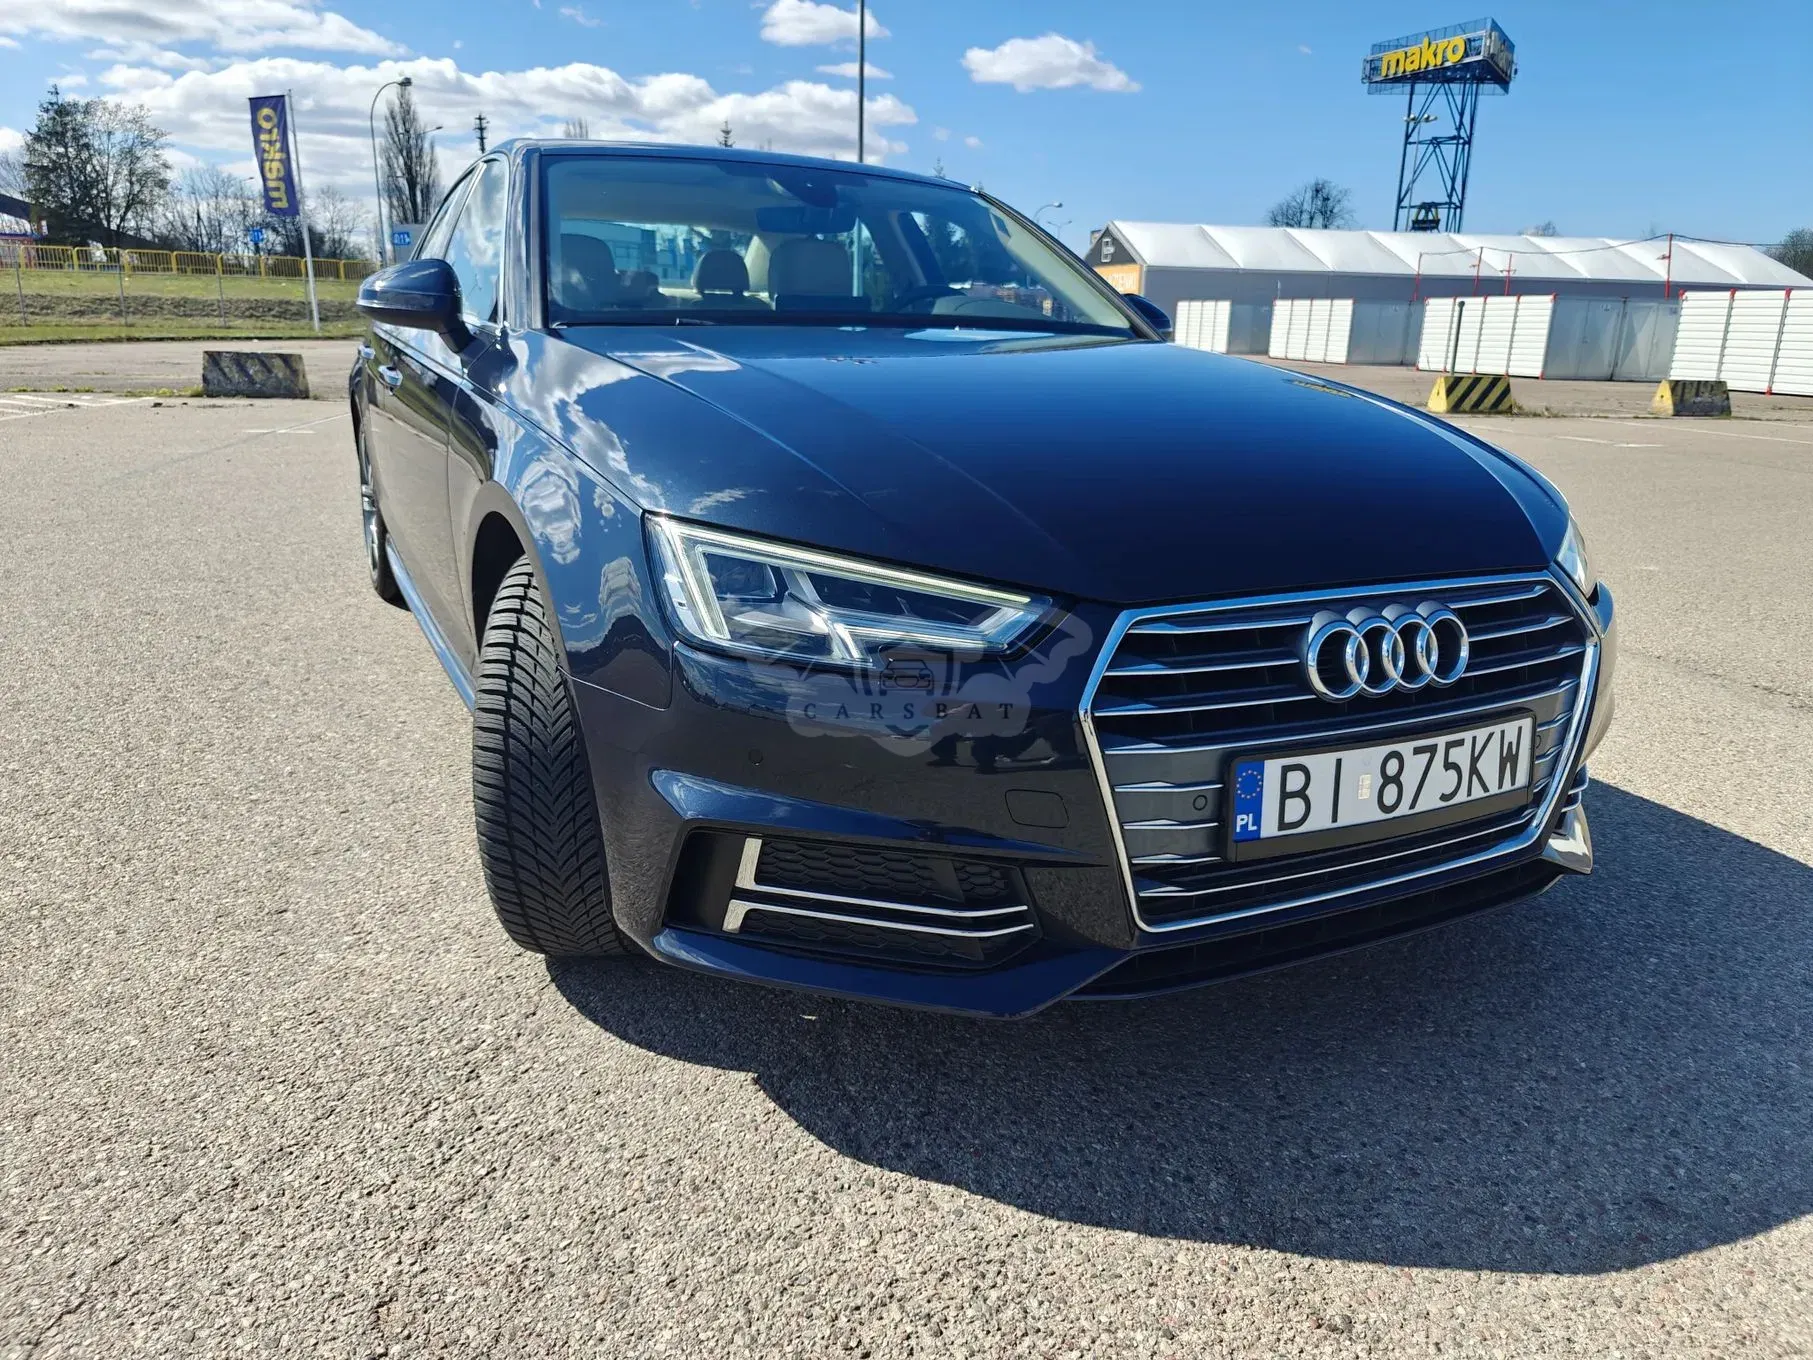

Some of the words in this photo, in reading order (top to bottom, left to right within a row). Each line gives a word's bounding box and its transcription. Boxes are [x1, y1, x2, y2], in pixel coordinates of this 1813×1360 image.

[1381, 36, 1466, 77] makro
[1277, 758, 1342, 832] BI
[1377, 726, 1523, 815] 875KW
[1235, 815, 1258, 833] PL
